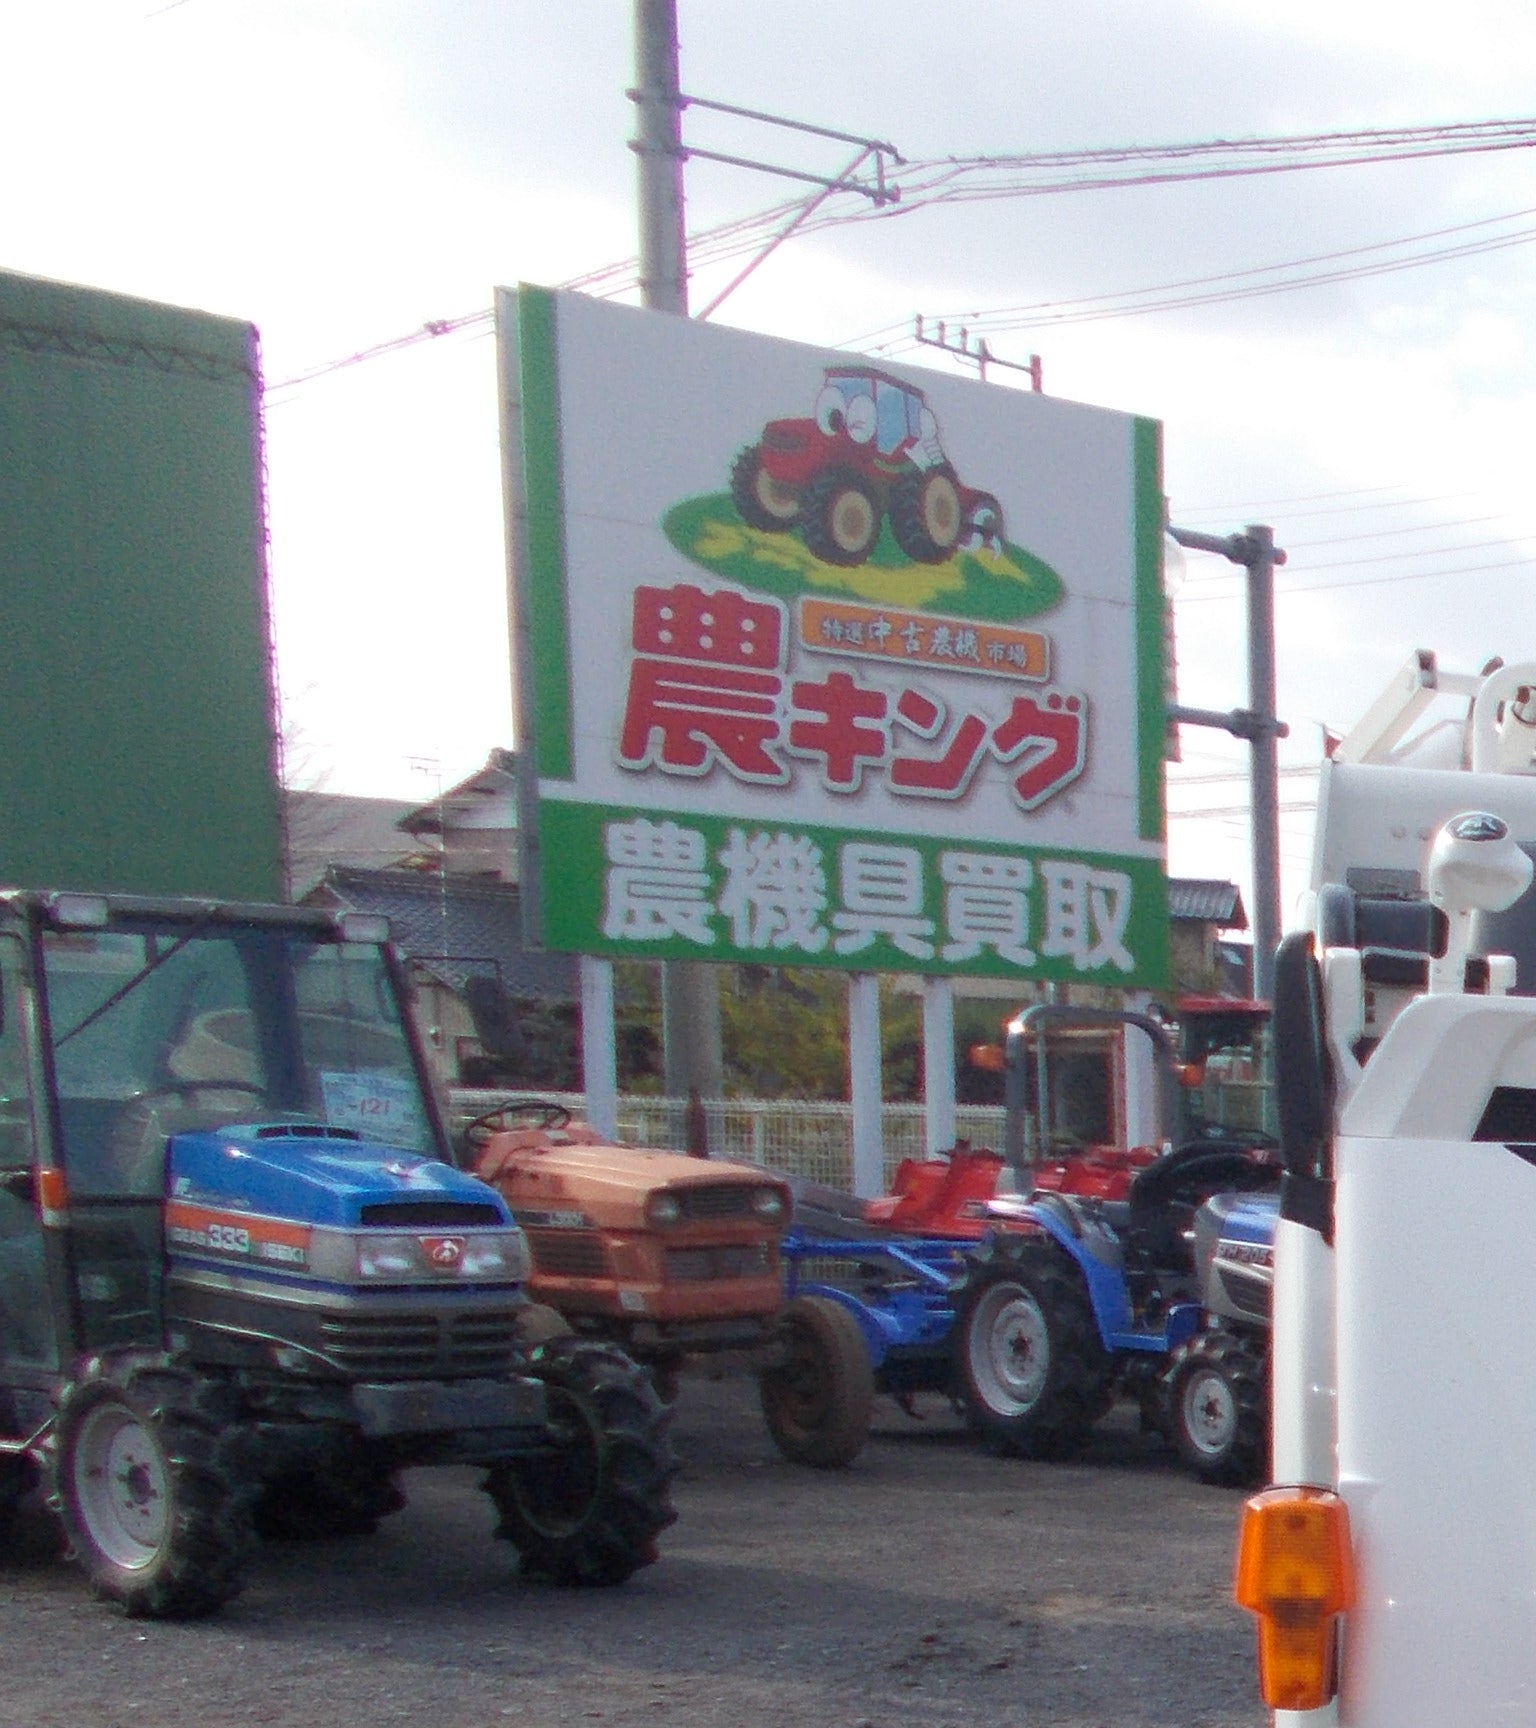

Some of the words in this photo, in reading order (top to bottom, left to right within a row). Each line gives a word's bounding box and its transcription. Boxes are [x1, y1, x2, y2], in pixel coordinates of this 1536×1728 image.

[618, 584, 1089, 809] 農キング
[603, 818, 1135, 973] 農機具買取
